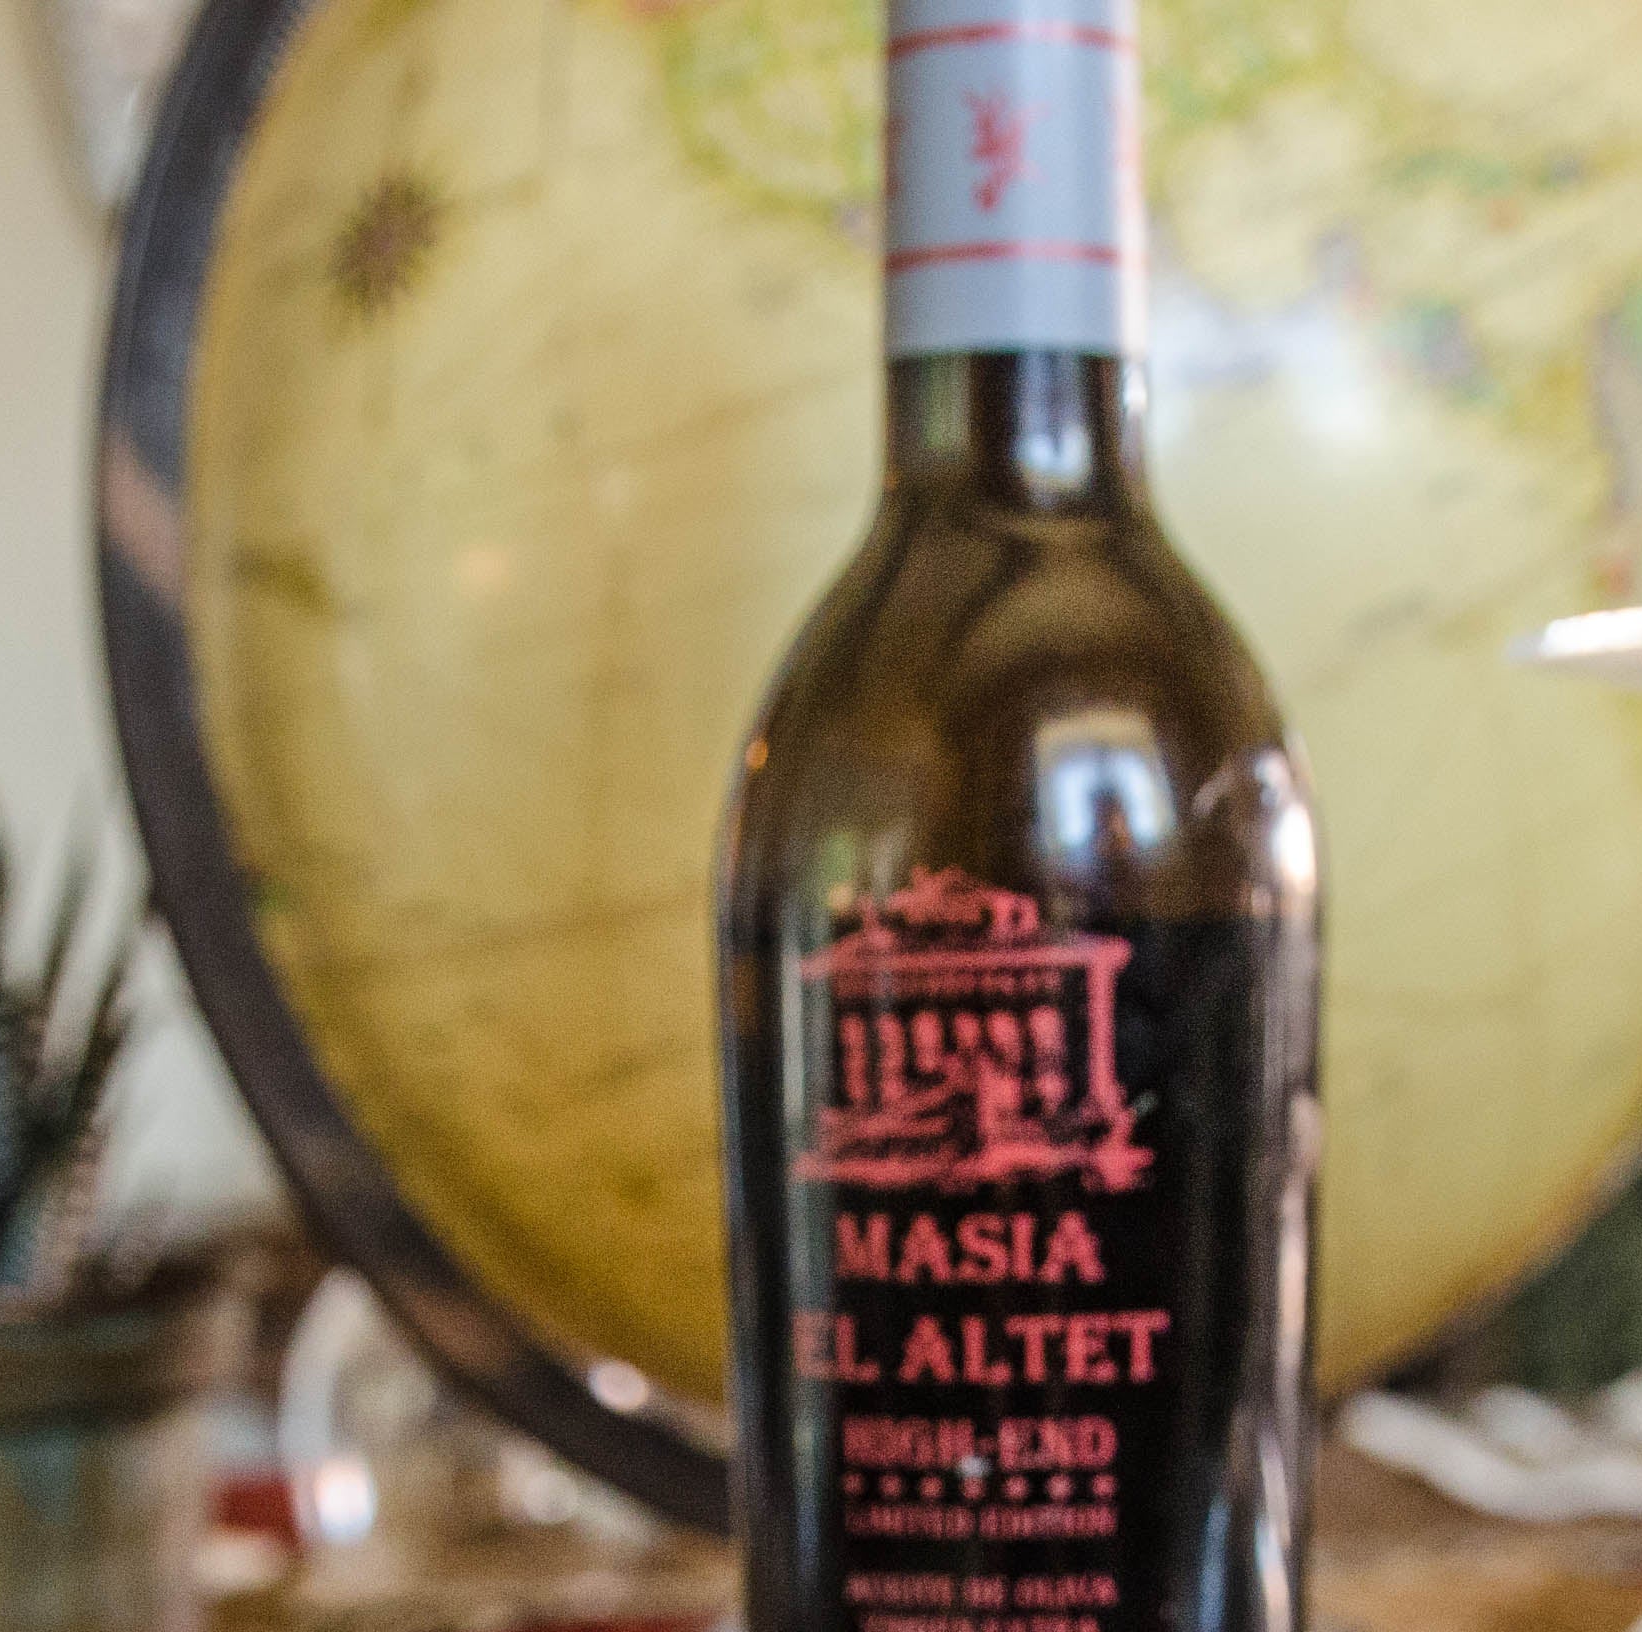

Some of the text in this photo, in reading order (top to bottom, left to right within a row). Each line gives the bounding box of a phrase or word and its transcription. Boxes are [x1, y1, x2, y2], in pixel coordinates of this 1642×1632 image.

[835, 1212, 1105, 1284] MASIA
[793, 1309, 1170, 1385] EL ALTET
